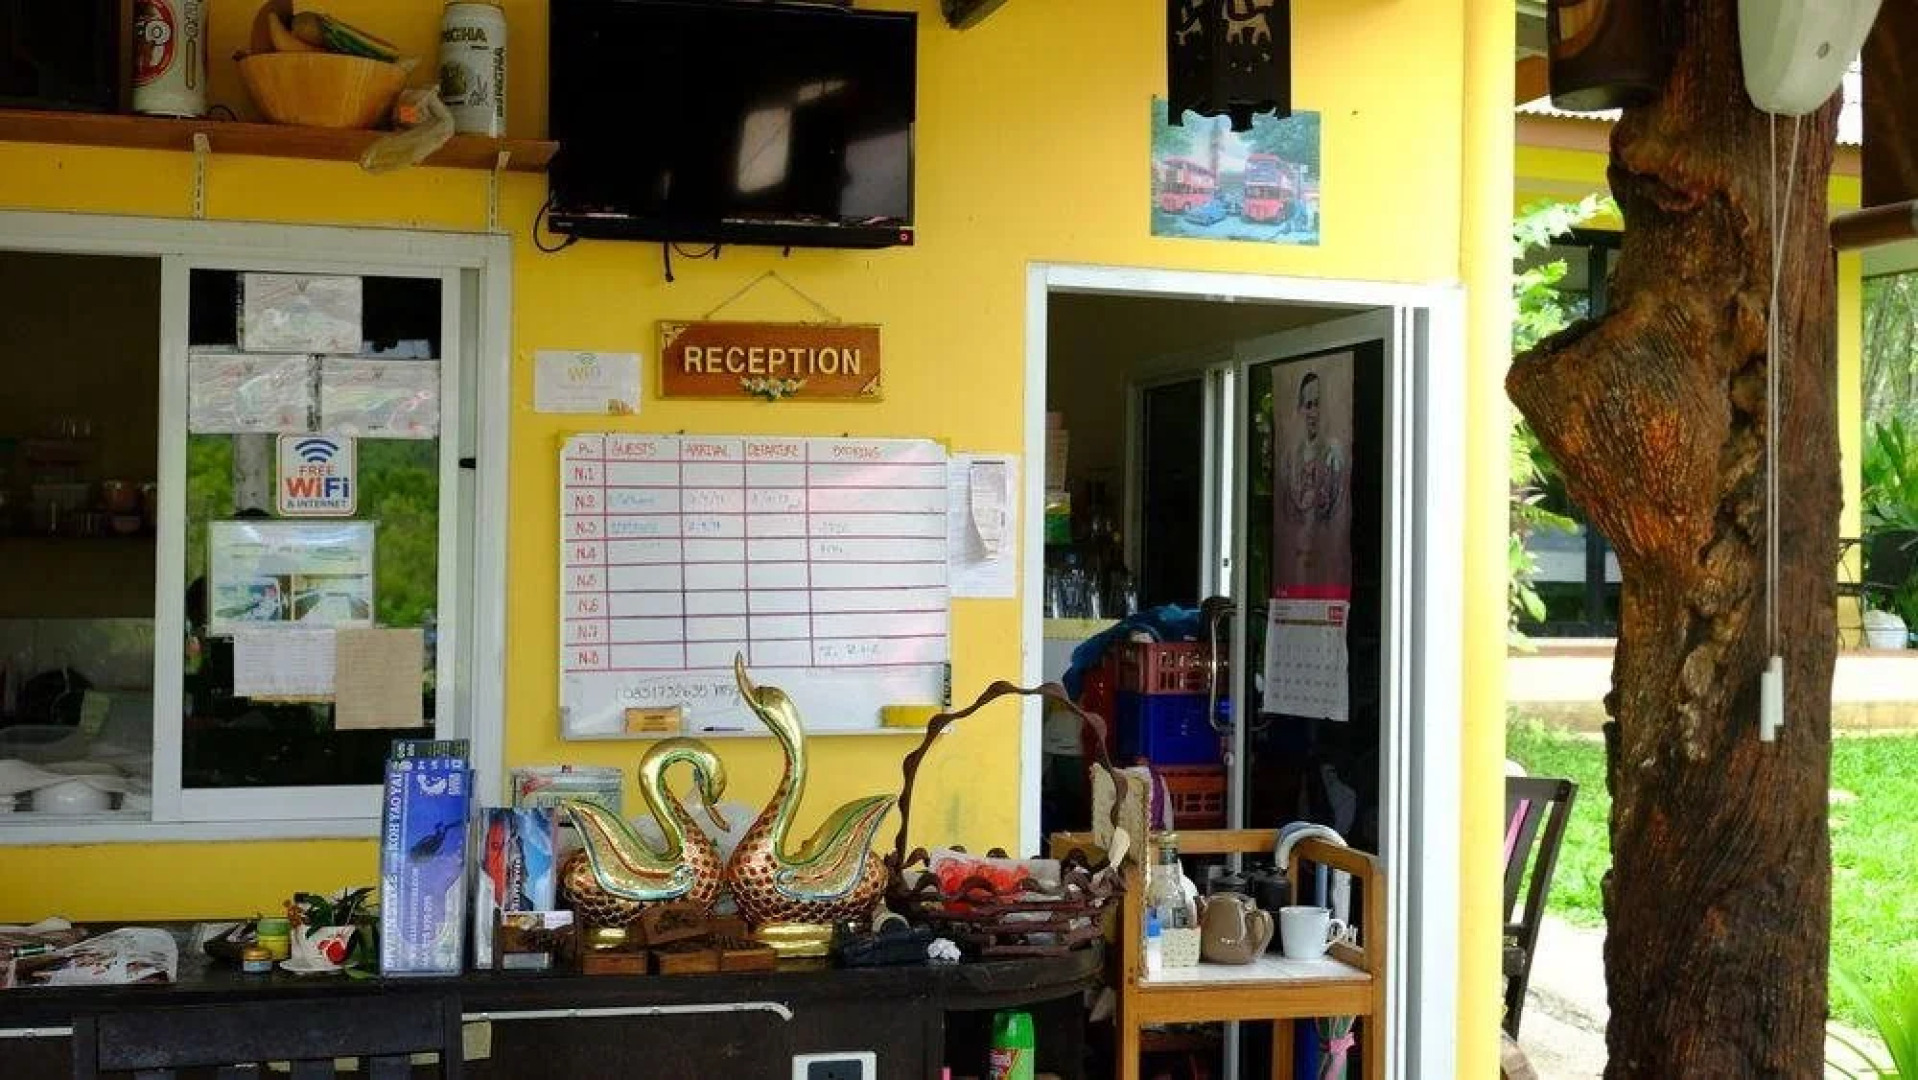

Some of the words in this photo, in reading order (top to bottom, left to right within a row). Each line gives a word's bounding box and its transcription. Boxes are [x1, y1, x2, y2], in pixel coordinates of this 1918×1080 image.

[684, 346, 861, 375] RECEPTION
[298, 465, 336, 477] FREE
[286, 477, 349, 498] WiFi
